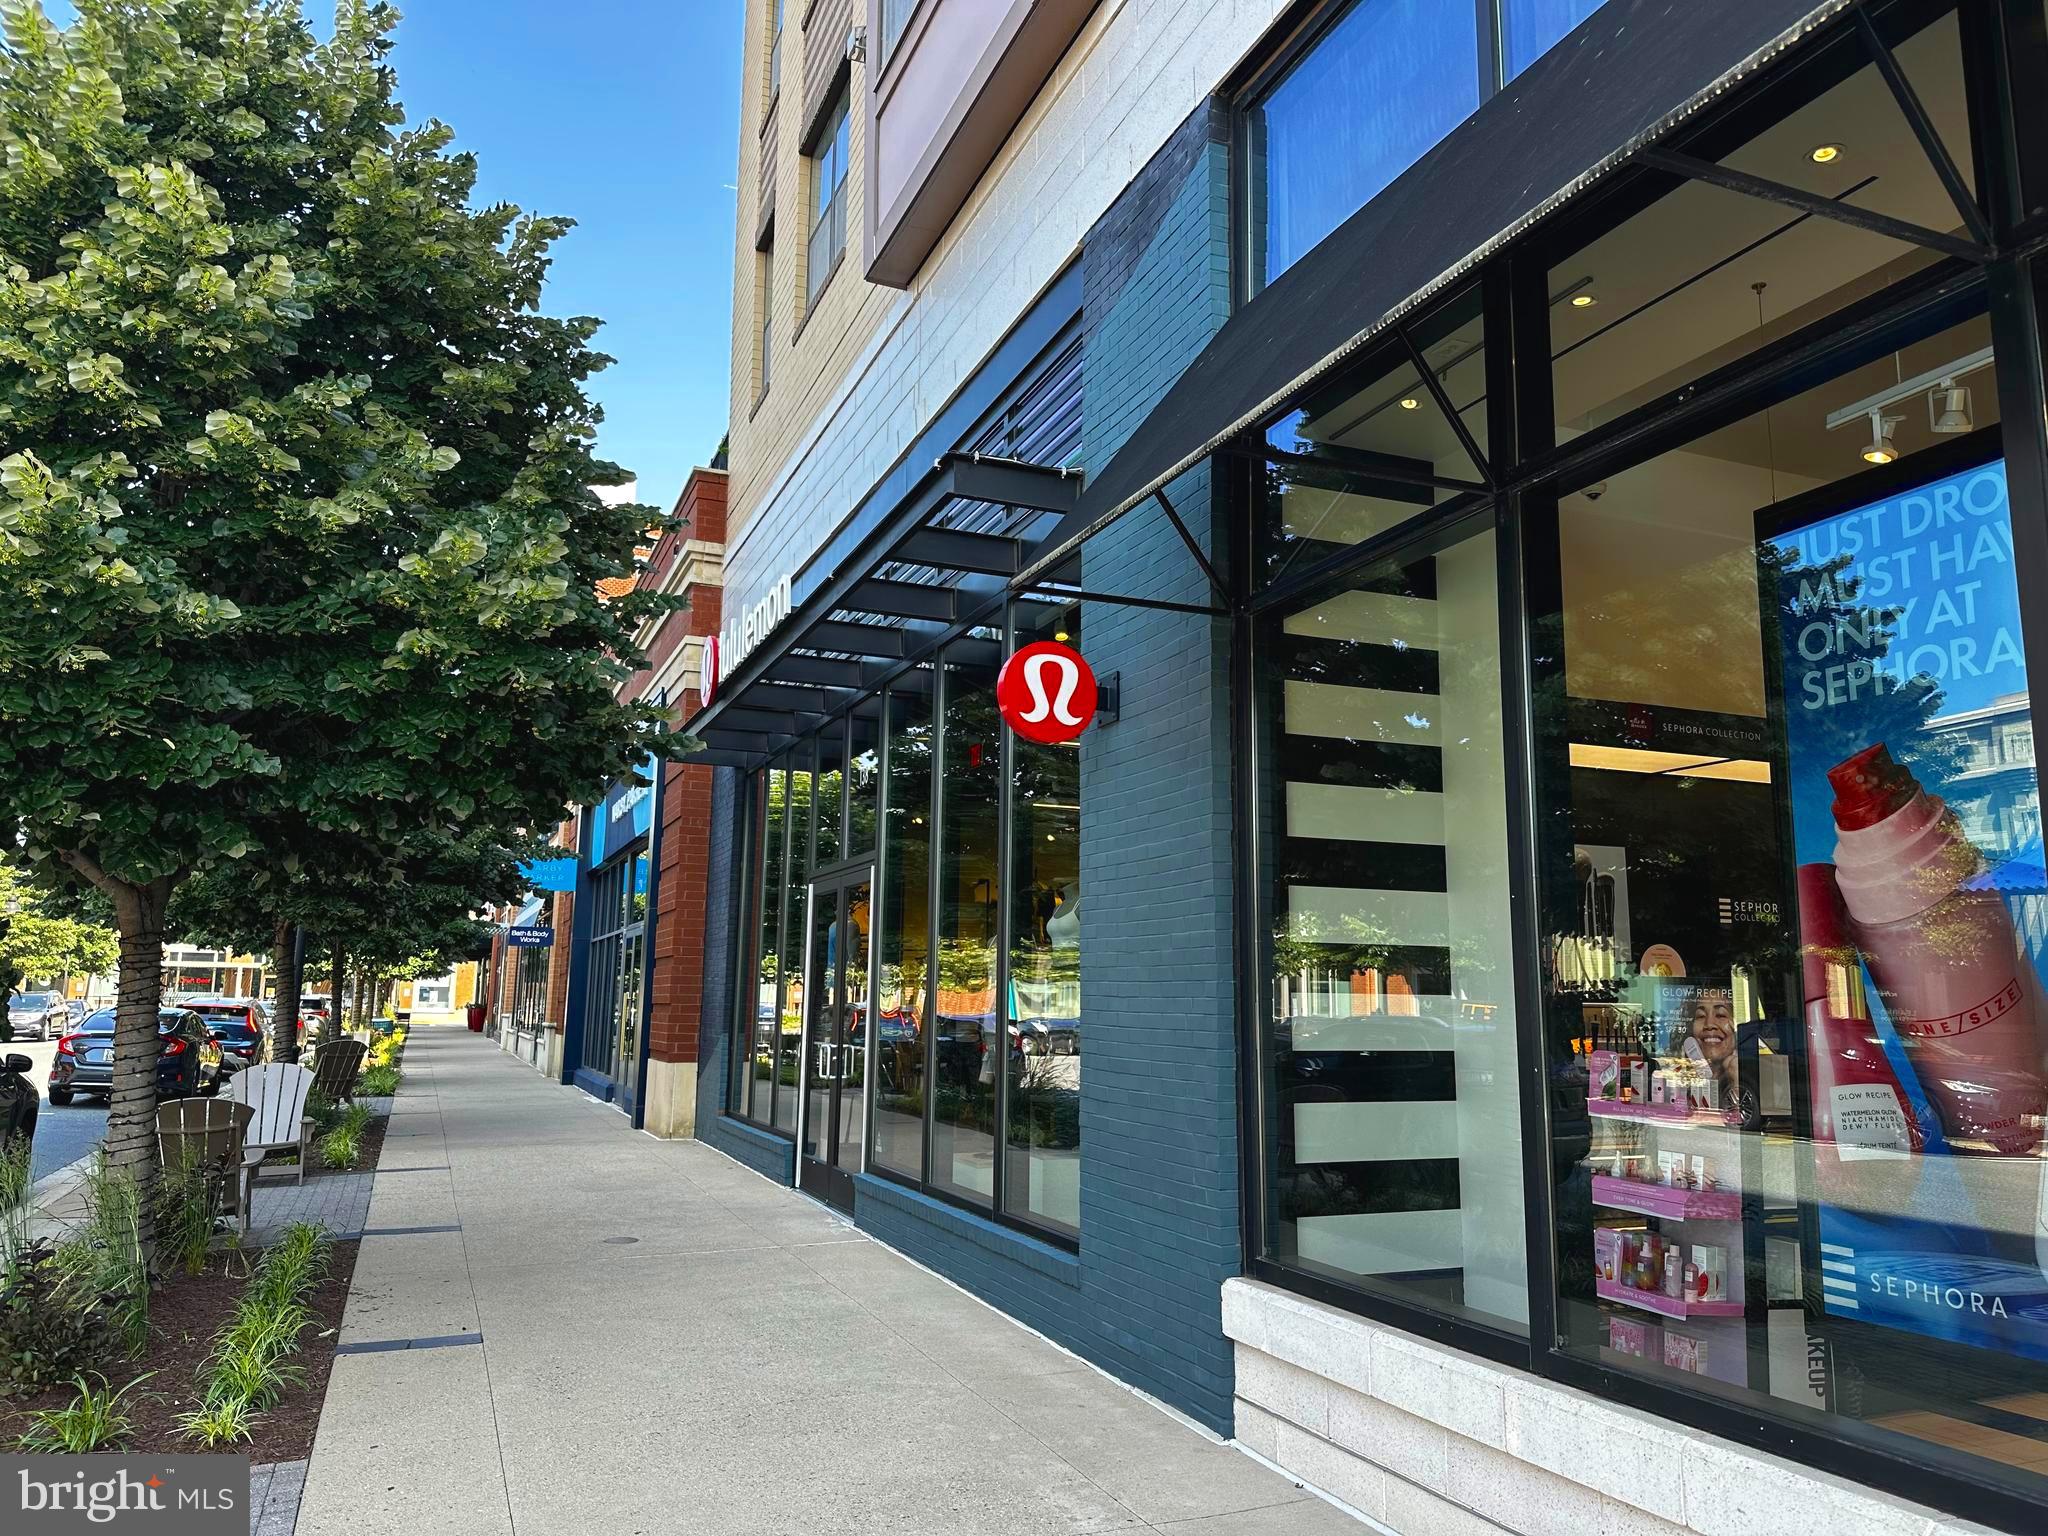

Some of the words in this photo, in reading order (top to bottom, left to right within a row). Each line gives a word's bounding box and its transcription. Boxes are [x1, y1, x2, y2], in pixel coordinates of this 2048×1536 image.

[1798, 507, 1886, 566] JUST
[1901, 471, 2007, 539] DRO
[1798, 550, 1916, 617] MUST
[719, 574, 791, 682] lululemon
[1798, 597, 1918, 661] ONLY
[1925, 581, 1982, 634] AT
[1802, 627, 2025, 710] SEPHORA
[1663, 723, 1703, 735] SEPHORA
[1706, 728, 1760, 740] COLLECTION
[532, 864, 563, 872] ARBY
[1662, 988, 1692, 997] GLOW
[1696, 988, 1733, 998] RECIPE
[1838, 1092, 1862, 1101] GLOW
[1842, 1123, 1868, 1131] DEWY
[1870, 1273, 2008, 1319] SEPHORA
